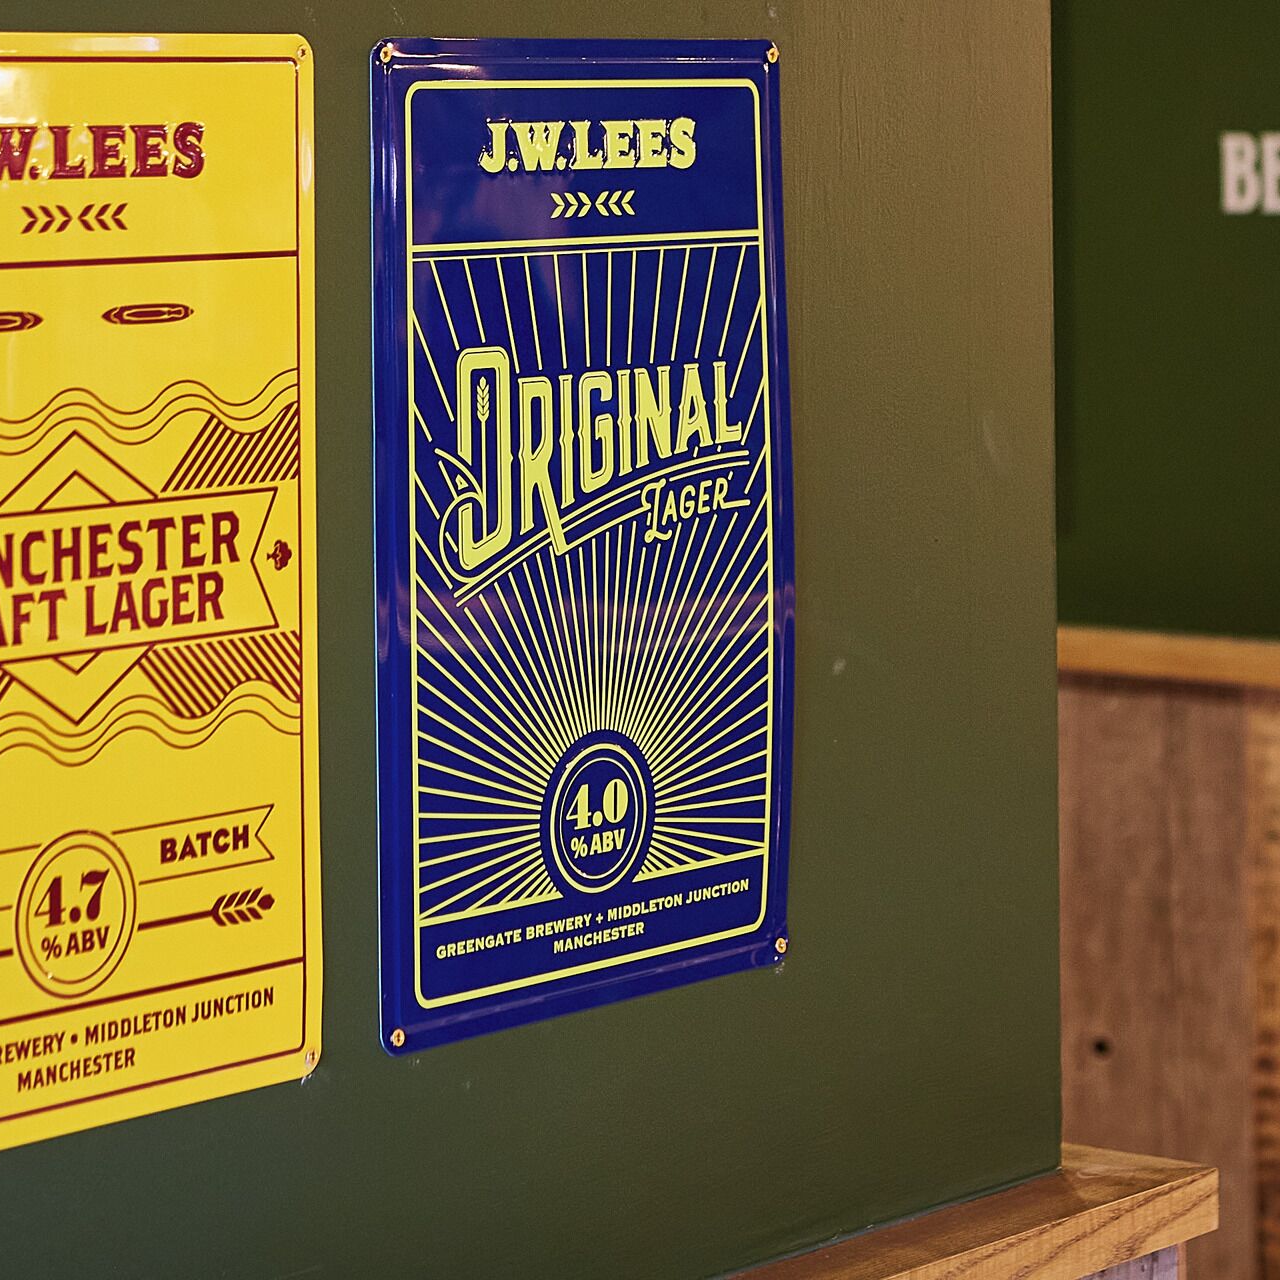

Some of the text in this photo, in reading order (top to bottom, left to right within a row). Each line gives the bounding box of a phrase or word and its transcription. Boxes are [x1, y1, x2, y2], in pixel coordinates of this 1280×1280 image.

[478, 117, 697, 173] J.W.LEES
[439, 345, 742, 584] ORIGINAL
[640, 472, 750, 541] LAGER
[84, 571, 225, 640] LAGER
[566, 778, 629, 830] 4.0
[160, 824, 250, 865] BATCH
[34, 868, 111, 928] 4.7
[436, 878, 750, 960] GREENGATE BREWERY MIDDLETON JUNCTION
[553, 922, 646, 954] MANCHESTER
[84, 1004, 187, 1045] MIDDLETON
[191, 987, 274, 1023] JUNCTION
[17, 1048, 136, 1093] MANCHESTER
